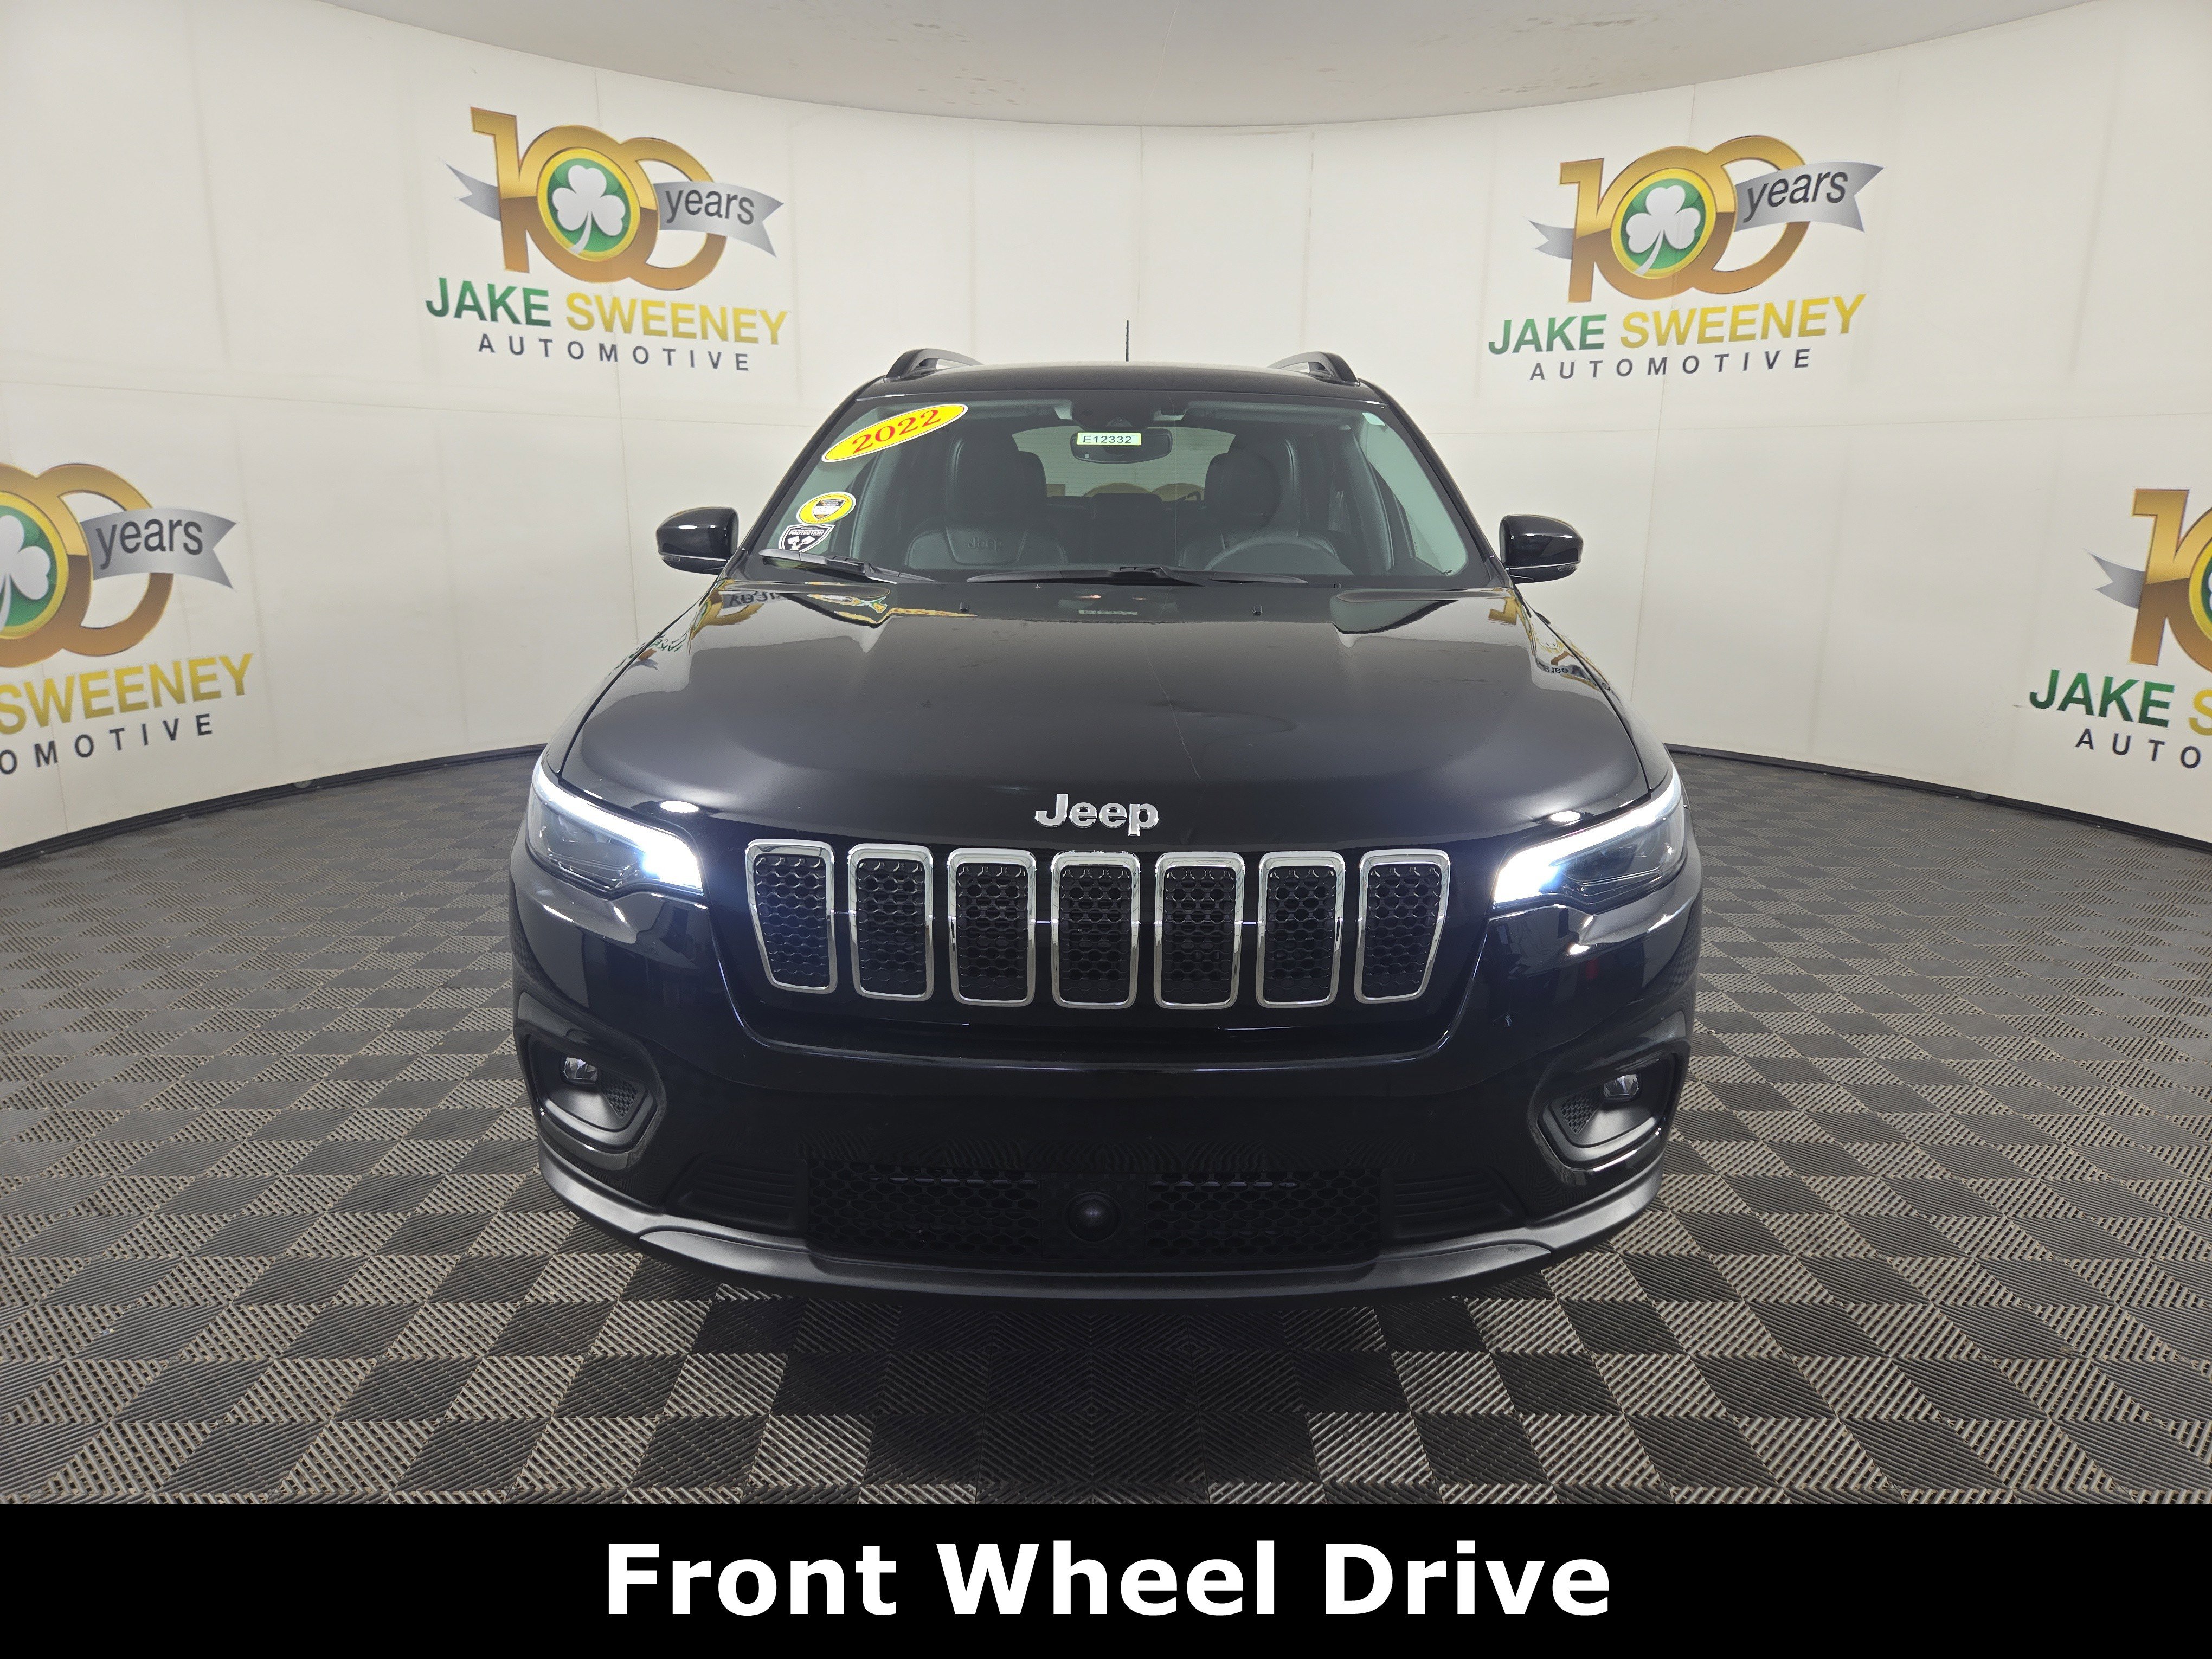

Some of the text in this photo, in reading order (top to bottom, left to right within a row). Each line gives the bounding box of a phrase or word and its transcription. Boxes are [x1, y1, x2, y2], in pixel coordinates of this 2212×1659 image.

[471, 107, 755, 290] 100 years
[1559, 135, 1848, 303] 100 years
[426, 277, 788, 345] JAKE SWEENEY
[1488, 293, 1867, 355] JAKE SWEENEY
[478, 333, 749, 371] AUTOMOTIVE
[1529, 348, 1811, 381] AUTOMOTIVE
[852, 409, 942, 454] 2022
[1083, 435, 1132, 443] E12332
[95, 518, 203, 570] years
[0, 653, 253, 735] SWEENEY
[2029, 669, 2175, 728] JAKE
[2075, 728, 2201, 769] AUTO
[1034, 793, 1159, 837] Jeep
